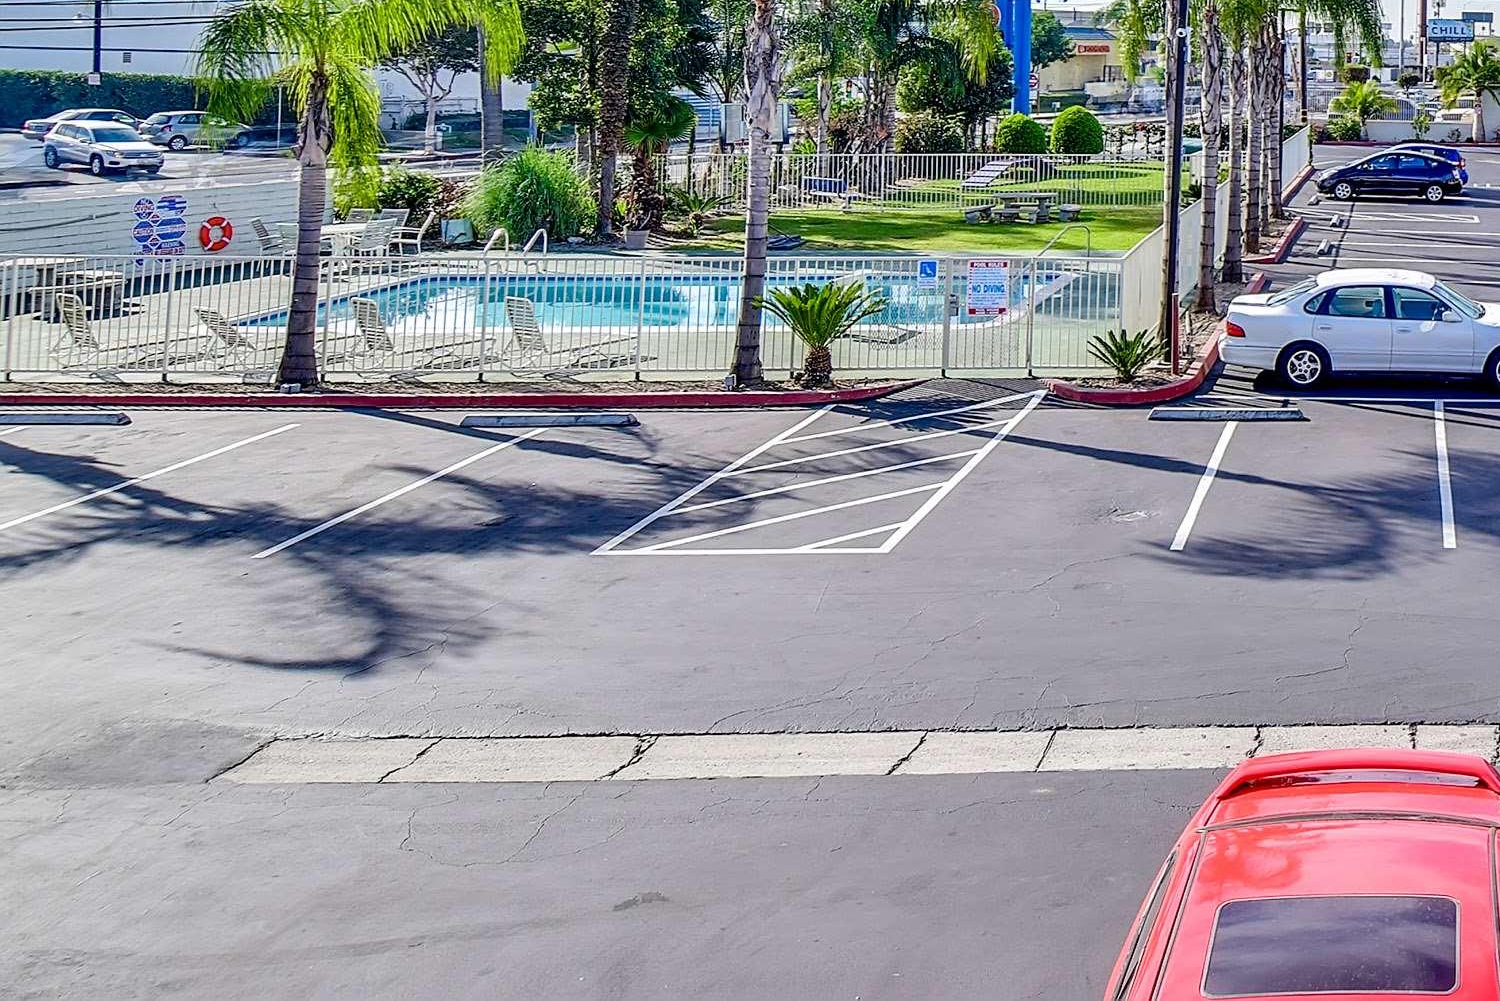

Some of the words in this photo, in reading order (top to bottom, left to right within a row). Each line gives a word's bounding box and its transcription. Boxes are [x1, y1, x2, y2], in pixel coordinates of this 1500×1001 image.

[1431, 26, 1467, 35] CHILL
[972, 284, 981, 293] NO
[983, 284, 1005, 293] DIVING
